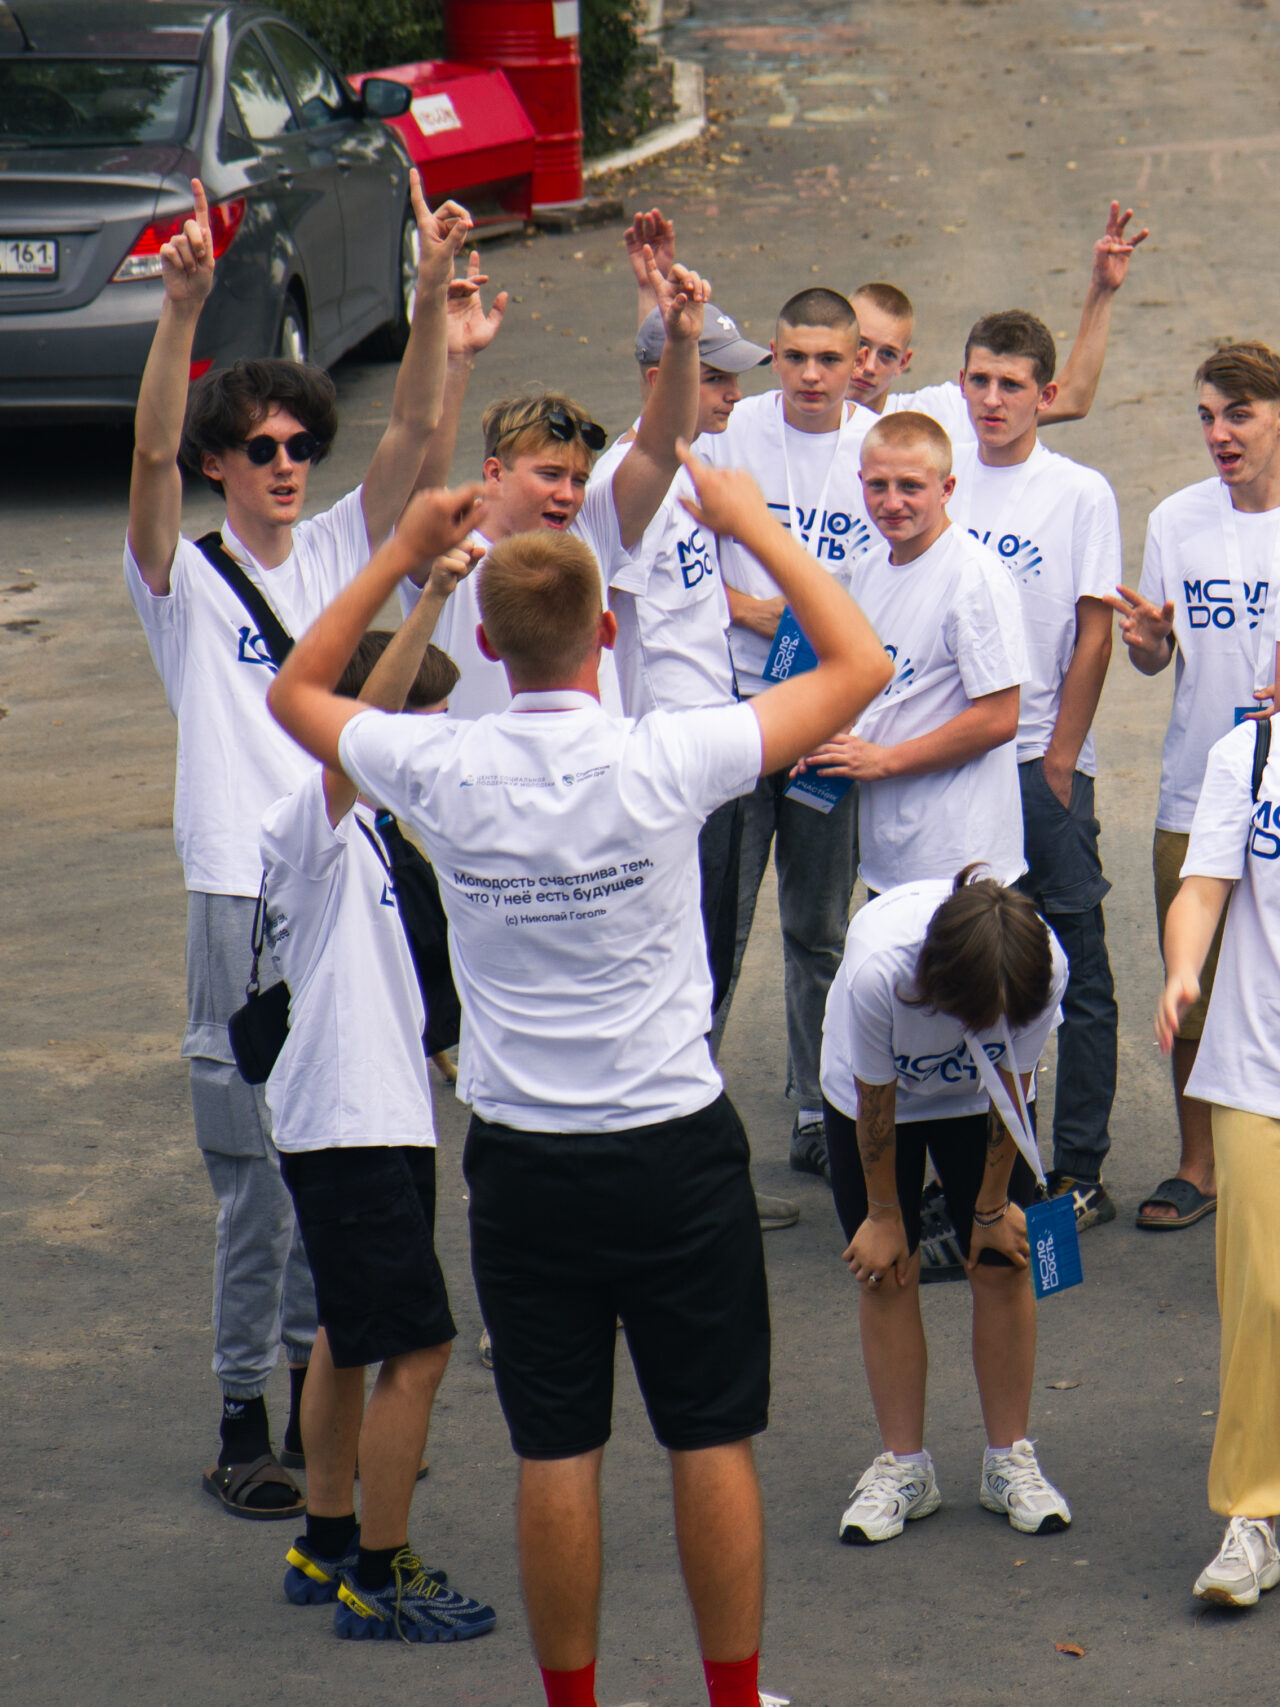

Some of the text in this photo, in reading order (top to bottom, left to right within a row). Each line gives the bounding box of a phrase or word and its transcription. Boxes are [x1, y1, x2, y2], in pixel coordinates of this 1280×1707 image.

[10, 242, 48, 264] 161
[453, 857, 654, 890] Молодость счастлива тем,
[465, 875, 644, 907] что у неё есть будущее
[521, 911, 568, 924] Николай
[570, 908, 607, 921] Гоголь
